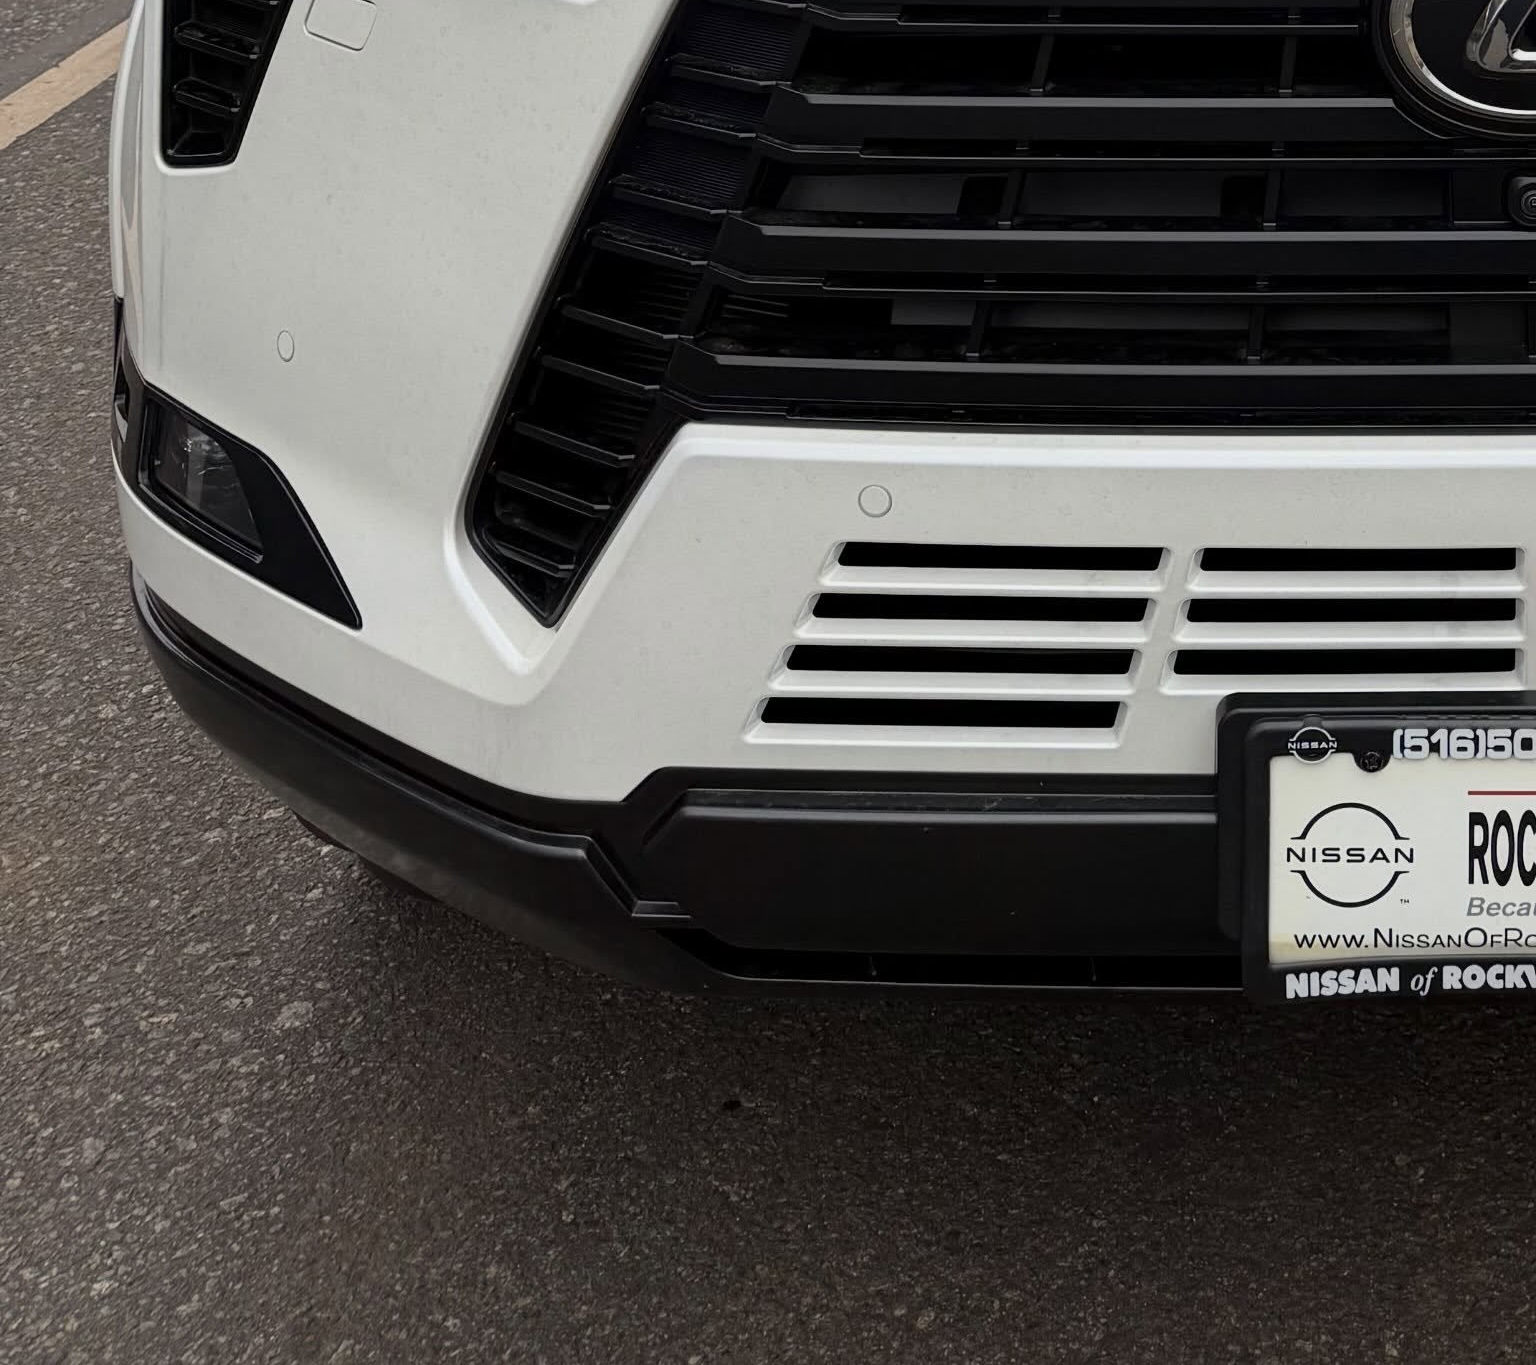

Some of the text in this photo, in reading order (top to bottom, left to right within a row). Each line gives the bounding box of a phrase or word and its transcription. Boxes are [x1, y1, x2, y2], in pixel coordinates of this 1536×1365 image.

[1287, 740, 1338, 750] NISSAN
[1286, 847, 1414, 863] NISSAN
[1285, 966, 1400, 1000] NISSAN
[1410, 966, 1438, 997] of
